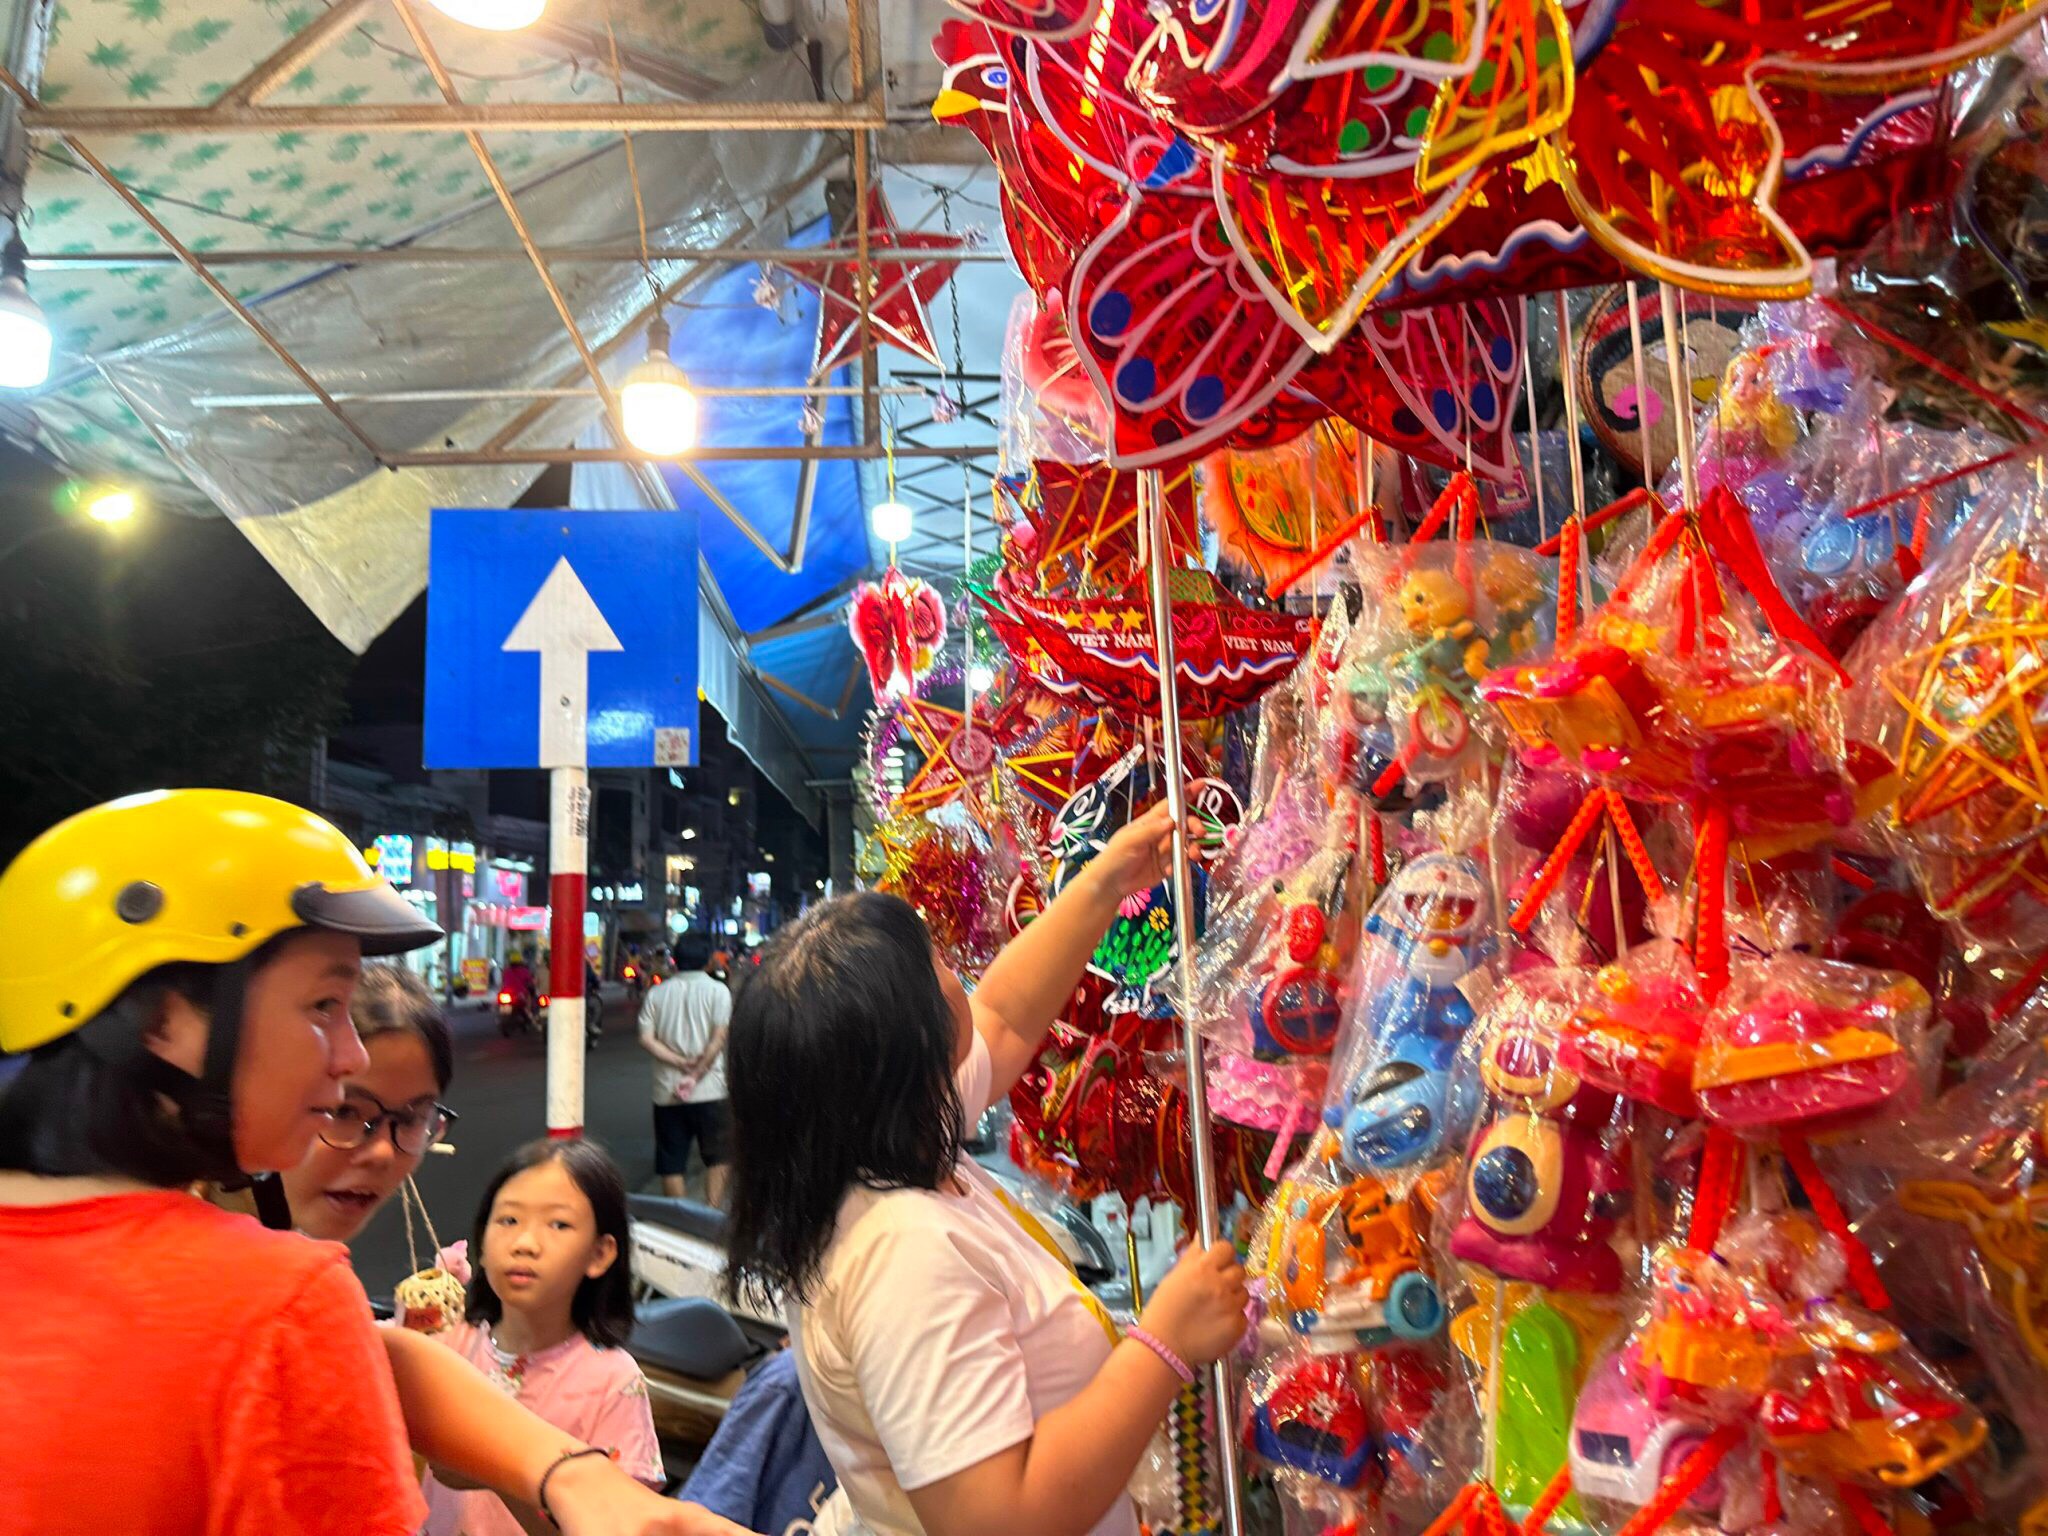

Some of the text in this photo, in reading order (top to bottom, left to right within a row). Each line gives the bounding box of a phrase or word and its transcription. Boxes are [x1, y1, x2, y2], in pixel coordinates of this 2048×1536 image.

[1067, 632, 1153, 649] VIET NAM
[1223, 634, 1296, 653] VIET NAM
